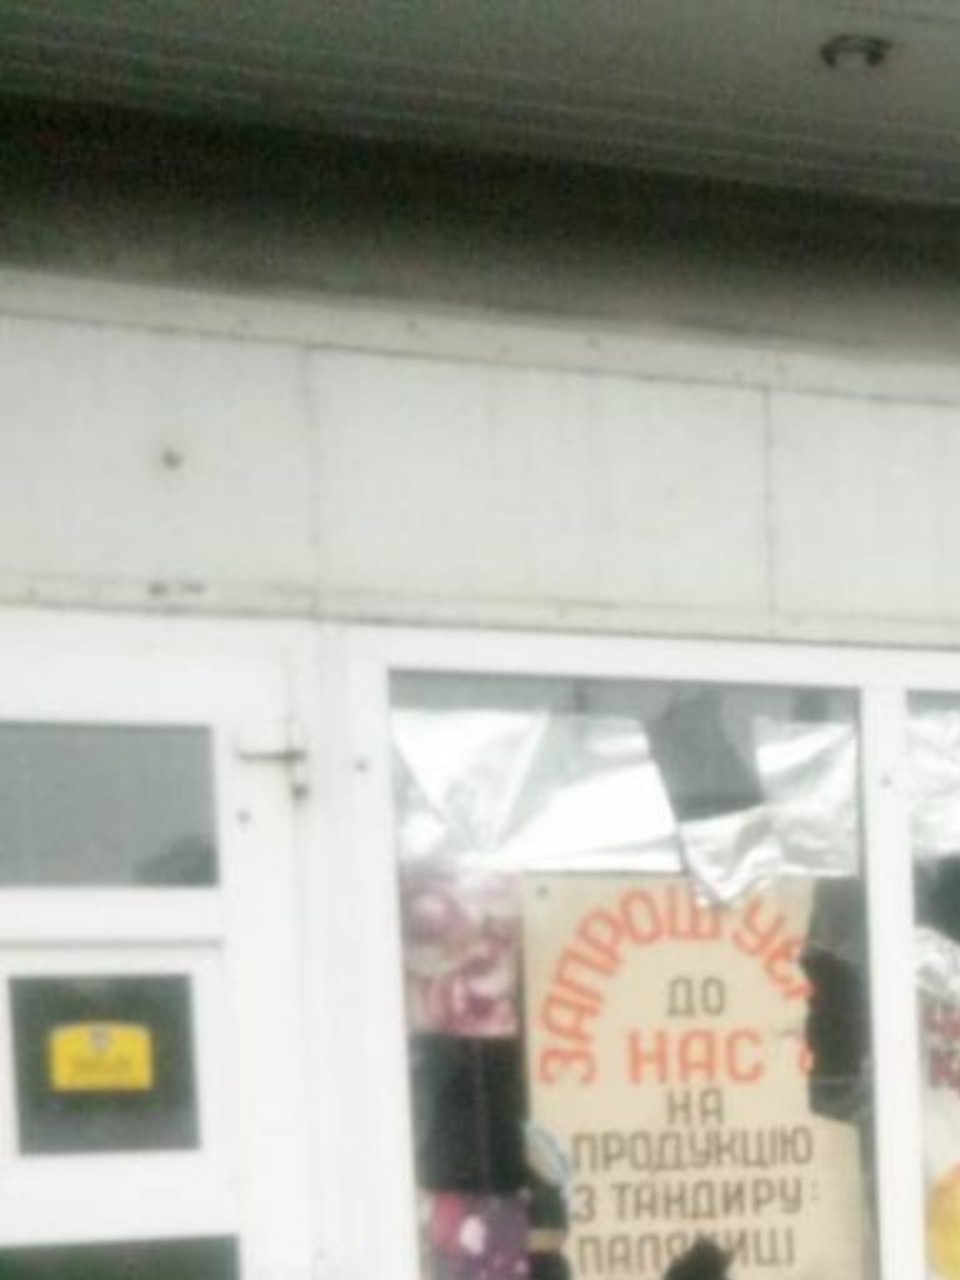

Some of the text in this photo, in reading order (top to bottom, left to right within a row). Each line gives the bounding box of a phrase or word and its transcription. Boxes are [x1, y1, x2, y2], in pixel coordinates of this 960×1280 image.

[666, 976, 727, 1018] ДО
[626, 1029, 764, 1085] НАС
[667, 1089, 724, 1126] НА
[571, 1126, 815, 1173] ПРОДУКЦІЮ
